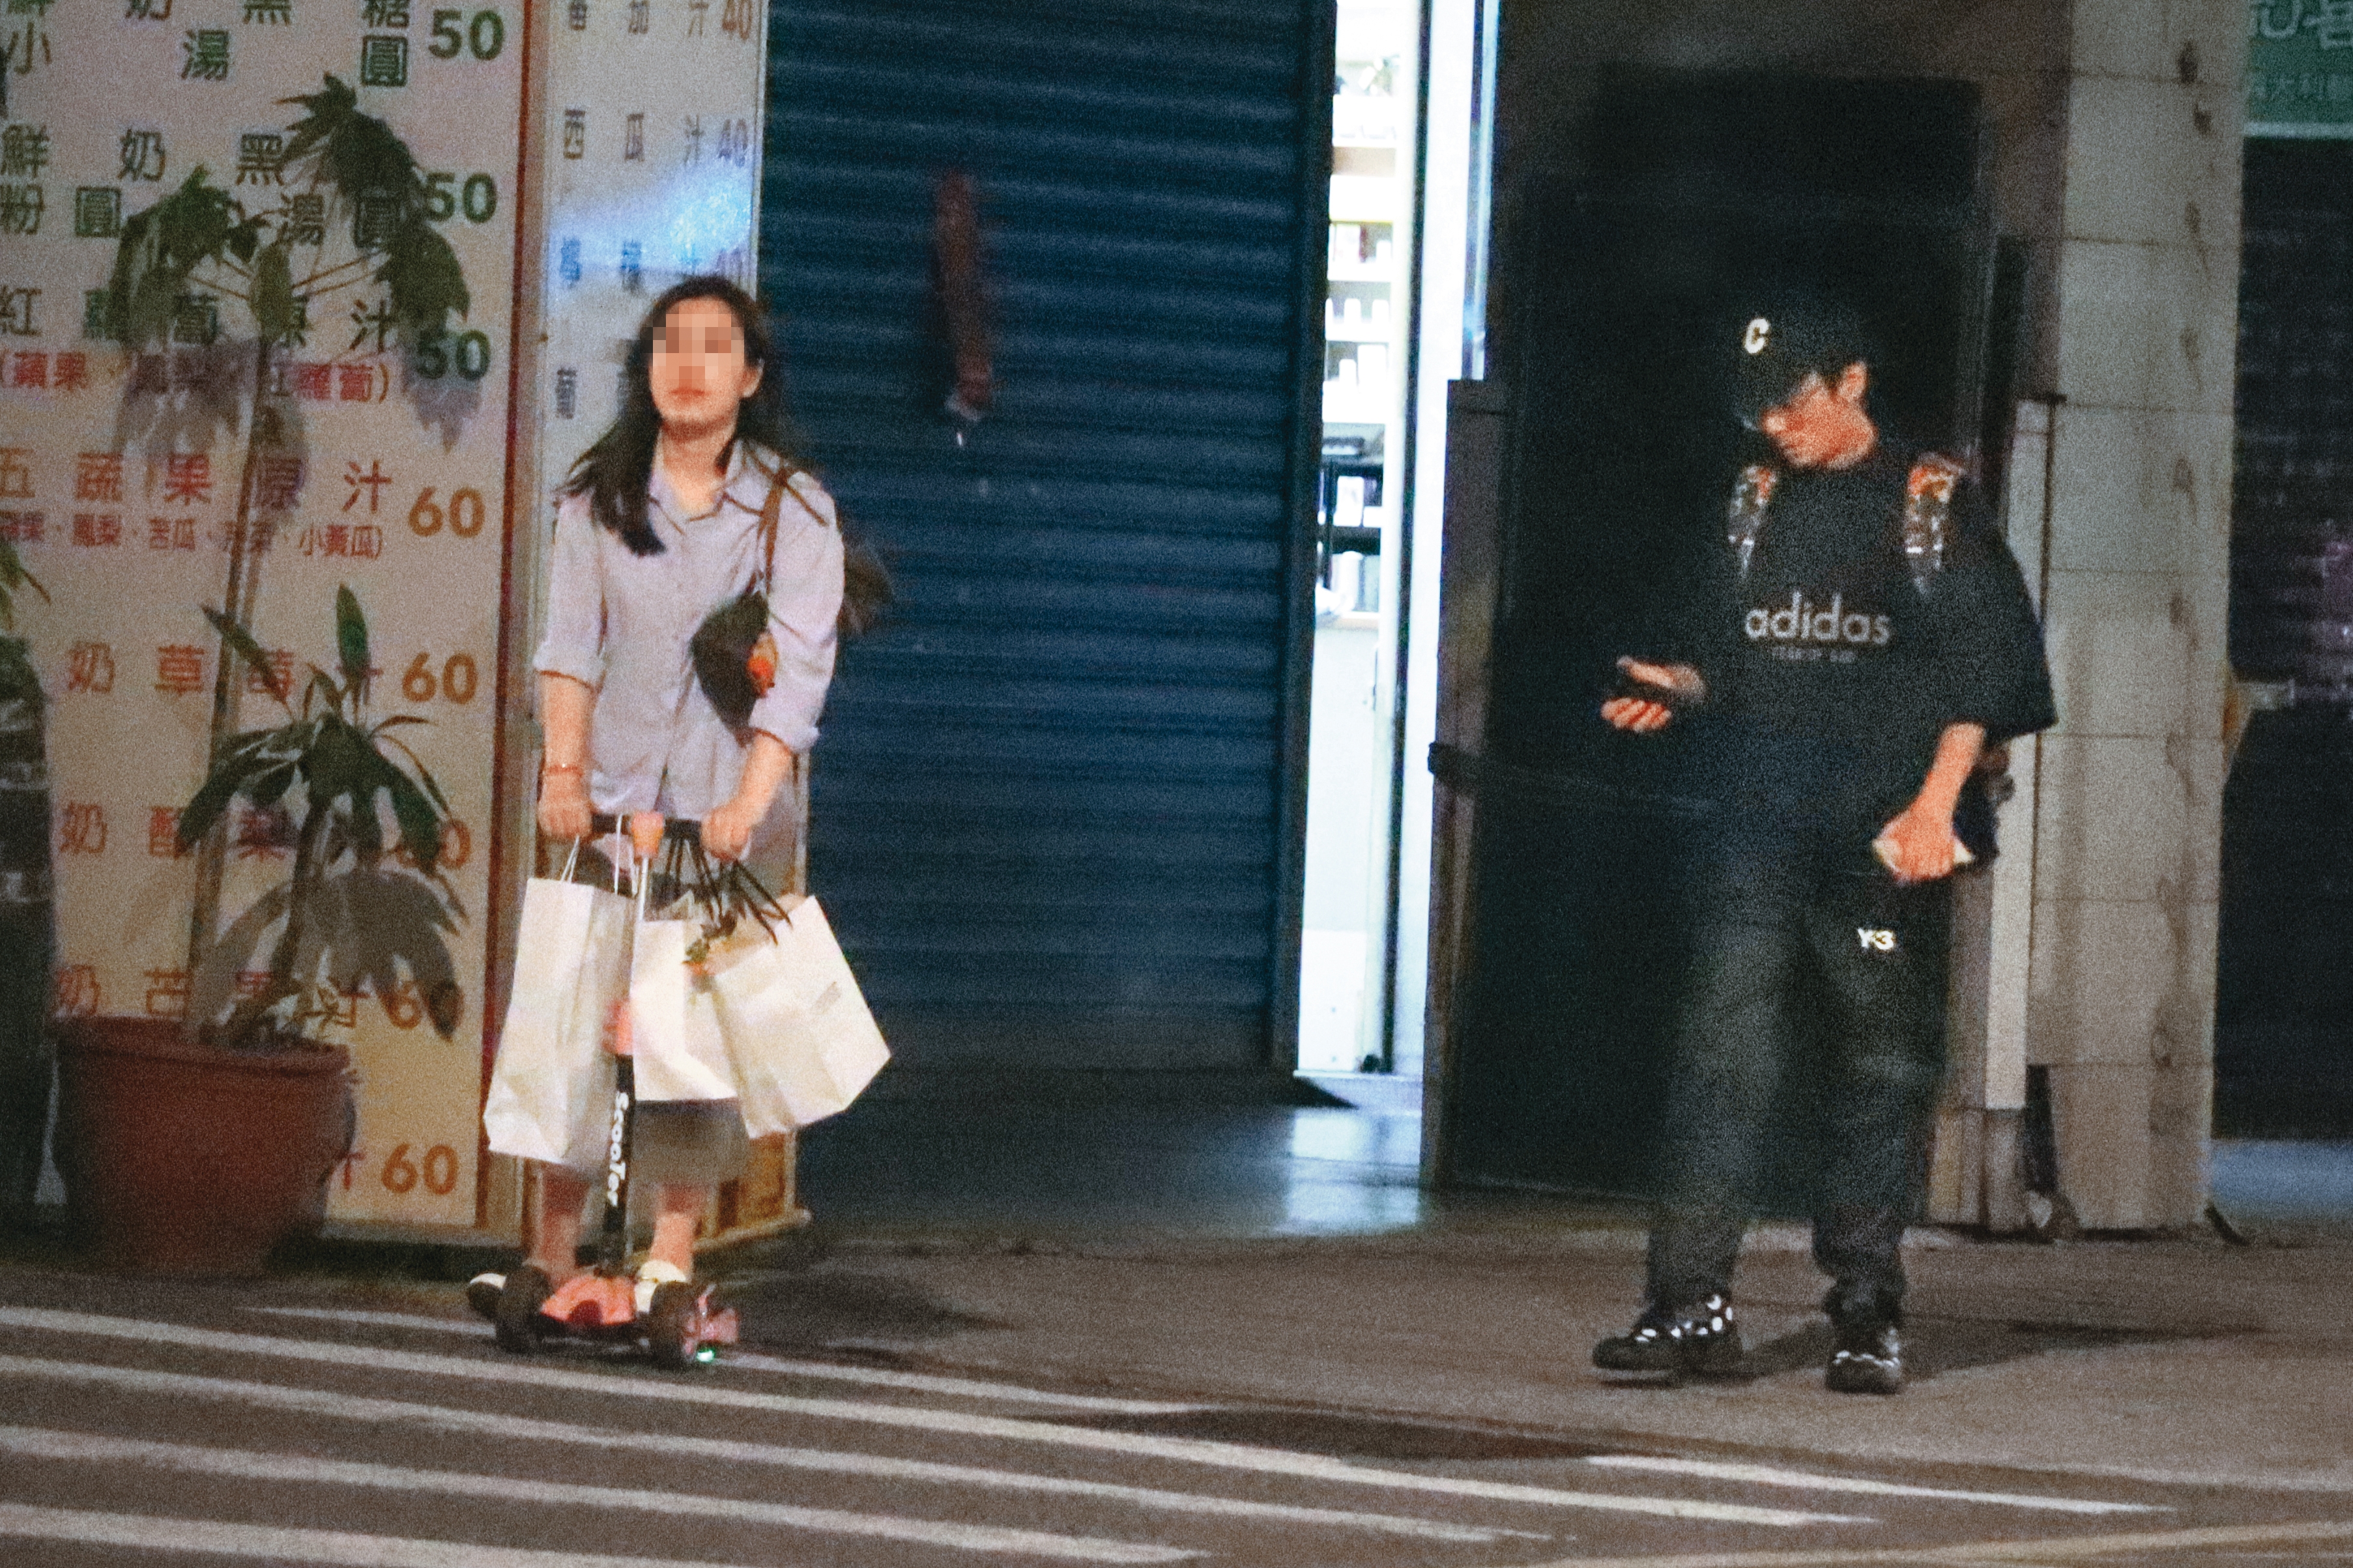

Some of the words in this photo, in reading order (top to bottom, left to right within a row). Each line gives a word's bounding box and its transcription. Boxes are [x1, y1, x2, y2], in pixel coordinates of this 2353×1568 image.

[428, 8, 505, 61] 50
[427, 173, 497, 223] 50
[409, 486, 485, 538] 60
[1744, 590, 1892, 646] adidas
[402, 652, 477, 704] 60
[381, 1143, 459, 1195] 60
